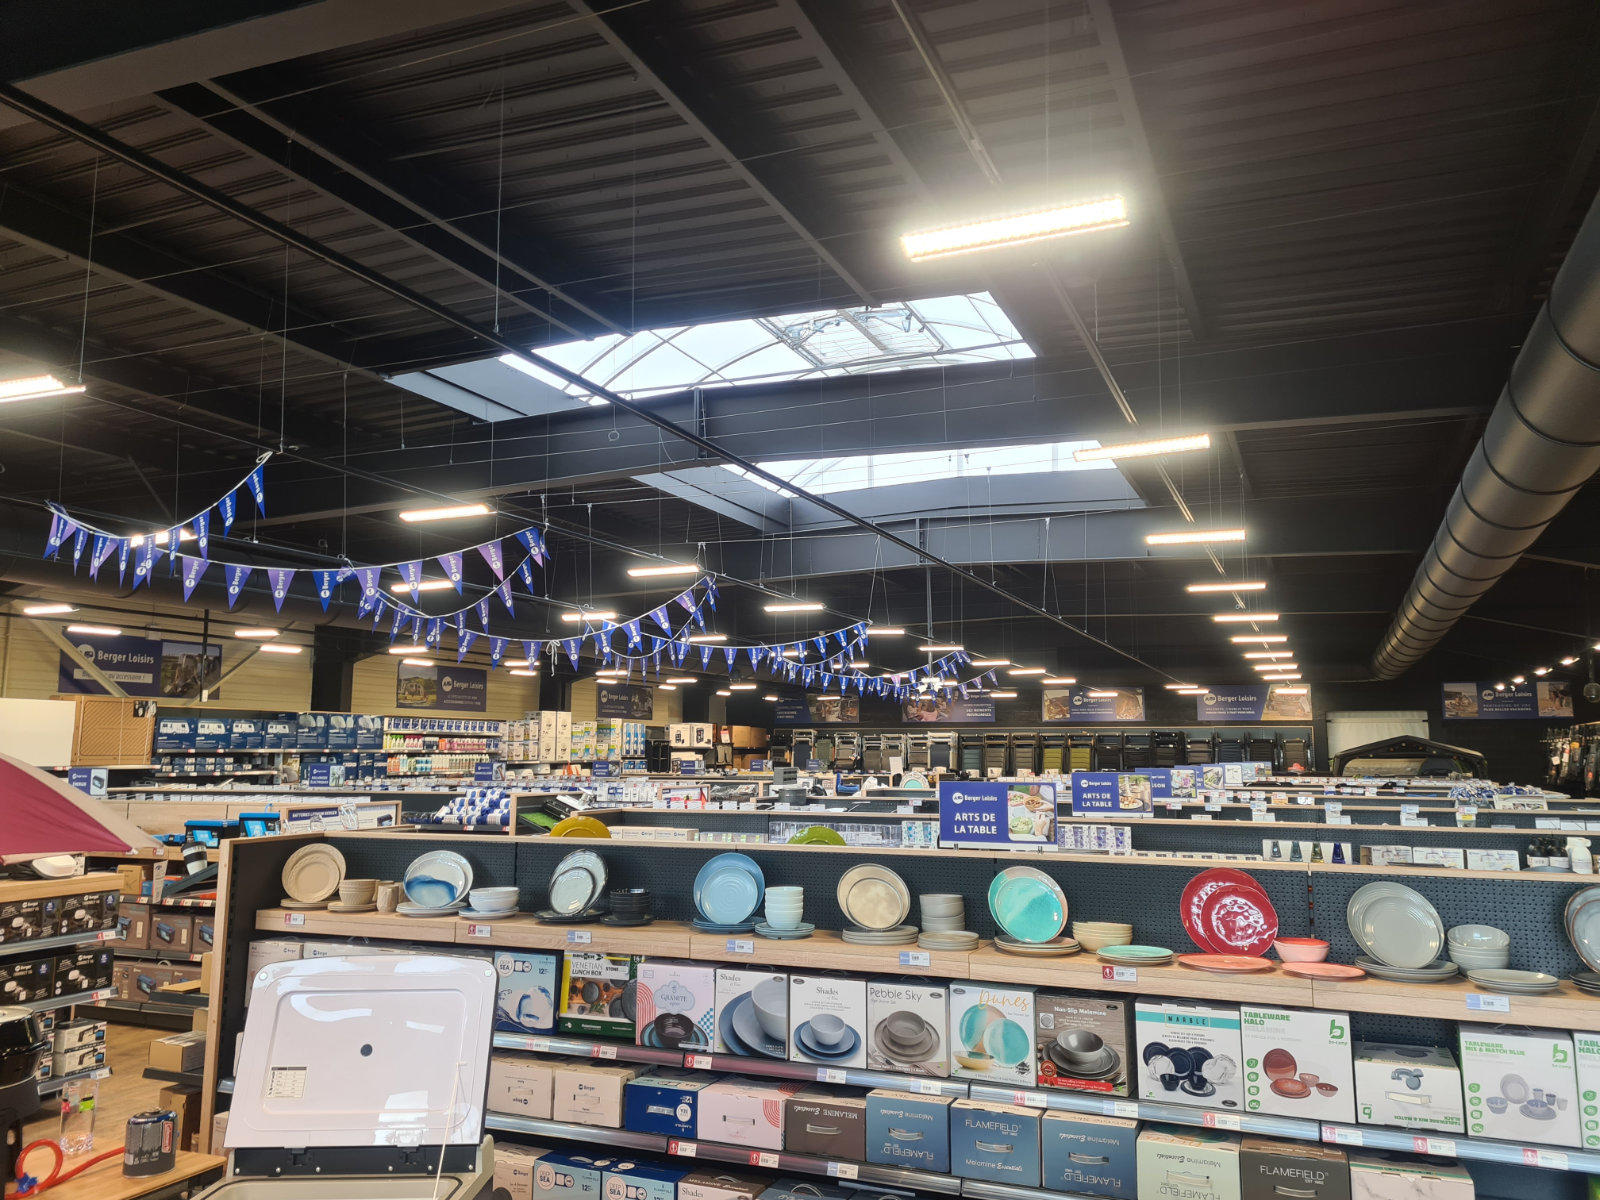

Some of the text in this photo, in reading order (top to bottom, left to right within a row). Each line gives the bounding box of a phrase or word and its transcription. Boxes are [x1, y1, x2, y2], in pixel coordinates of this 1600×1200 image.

[98, 650, 154, 664] Berger Loisirs
[454, 681, 484, 690] Berger Loisirs
[964, 794, 982, 804] Berger
[954, 812, 996, 822] ARTS DE
[954, 824, 997, 834] LA TABLE
[572, 962, 602, 970] VENETIAN
[720, 974, 740, 982] Shades
[816, 986, 839, 995] Shades
[870, 988, 922, 1002] Pebble Sky
[978, 990, 1030, 1012] Dunes
[1054, 1006, 1078, 1015] Non-Slip
[1244, 1012, 1290, 1021] TABLEWARE
[1168, 1016, 1206, 1025] MARBLE
[794, 1105, 858, 1119] MELAMINE Essentials
[880, 1109, 934, 1121] Melamine Essentials
[965, 1119, 1019, 1133] FLAMEFIELD
[1059, 1133, 1120, 1146] Melamine Essentials
[884, 1146, 934, 1160] FLAMEFIELD
[966, 1159, 1023, 1172] Melamine Essentials
[1156, 1153, 1221, 1168] Melamine Essentials
[1260, 1165, 1325, 1180] FLAMEFIELD
[1064, 1172, 1121, 1188] FLAMEFIELD
[682, 1188, 704, 1198] Shades
[1160, 1187, 1220, 1200] FLAMEFIELD
